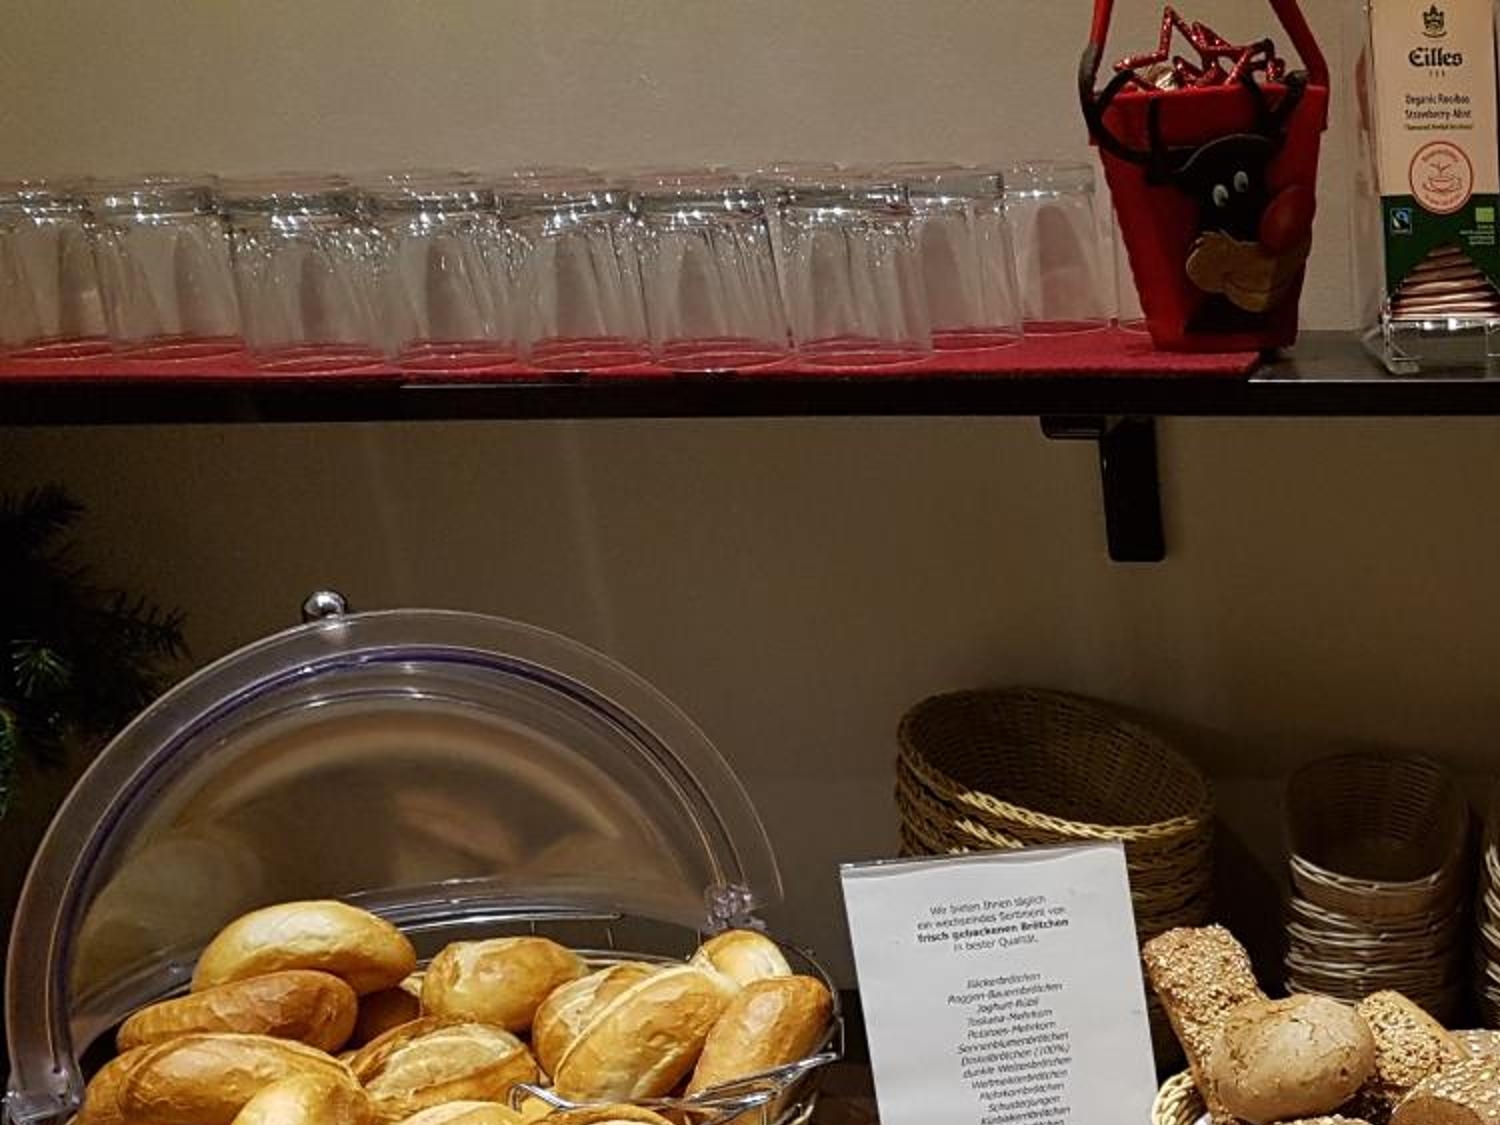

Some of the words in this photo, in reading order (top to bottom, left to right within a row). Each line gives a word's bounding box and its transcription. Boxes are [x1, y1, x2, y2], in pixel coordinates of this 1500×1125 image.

[1408, 47, 1463, 67] Eilles
[1405, 94, 1437, 106] Organic
[929, 905, 947, 915] Wir
[949, 901, 980, 914] bieten
[982, 898, 1013, 909] Ihnen
[1013, 894, 1046, 908] täglich
[916, 920, 932, 930] ein
[934, 913, 996, 927] wechselndes
[999, 907, 1045, 921] Sortiment
[916, 931, 949, 943] frisch
[951, 924, 1018, 939] gebackenen
[1020, 917, 1069, 931] Brötchen
[953, 943, 962, 951] in
[964, 938, 996, 951] bester
